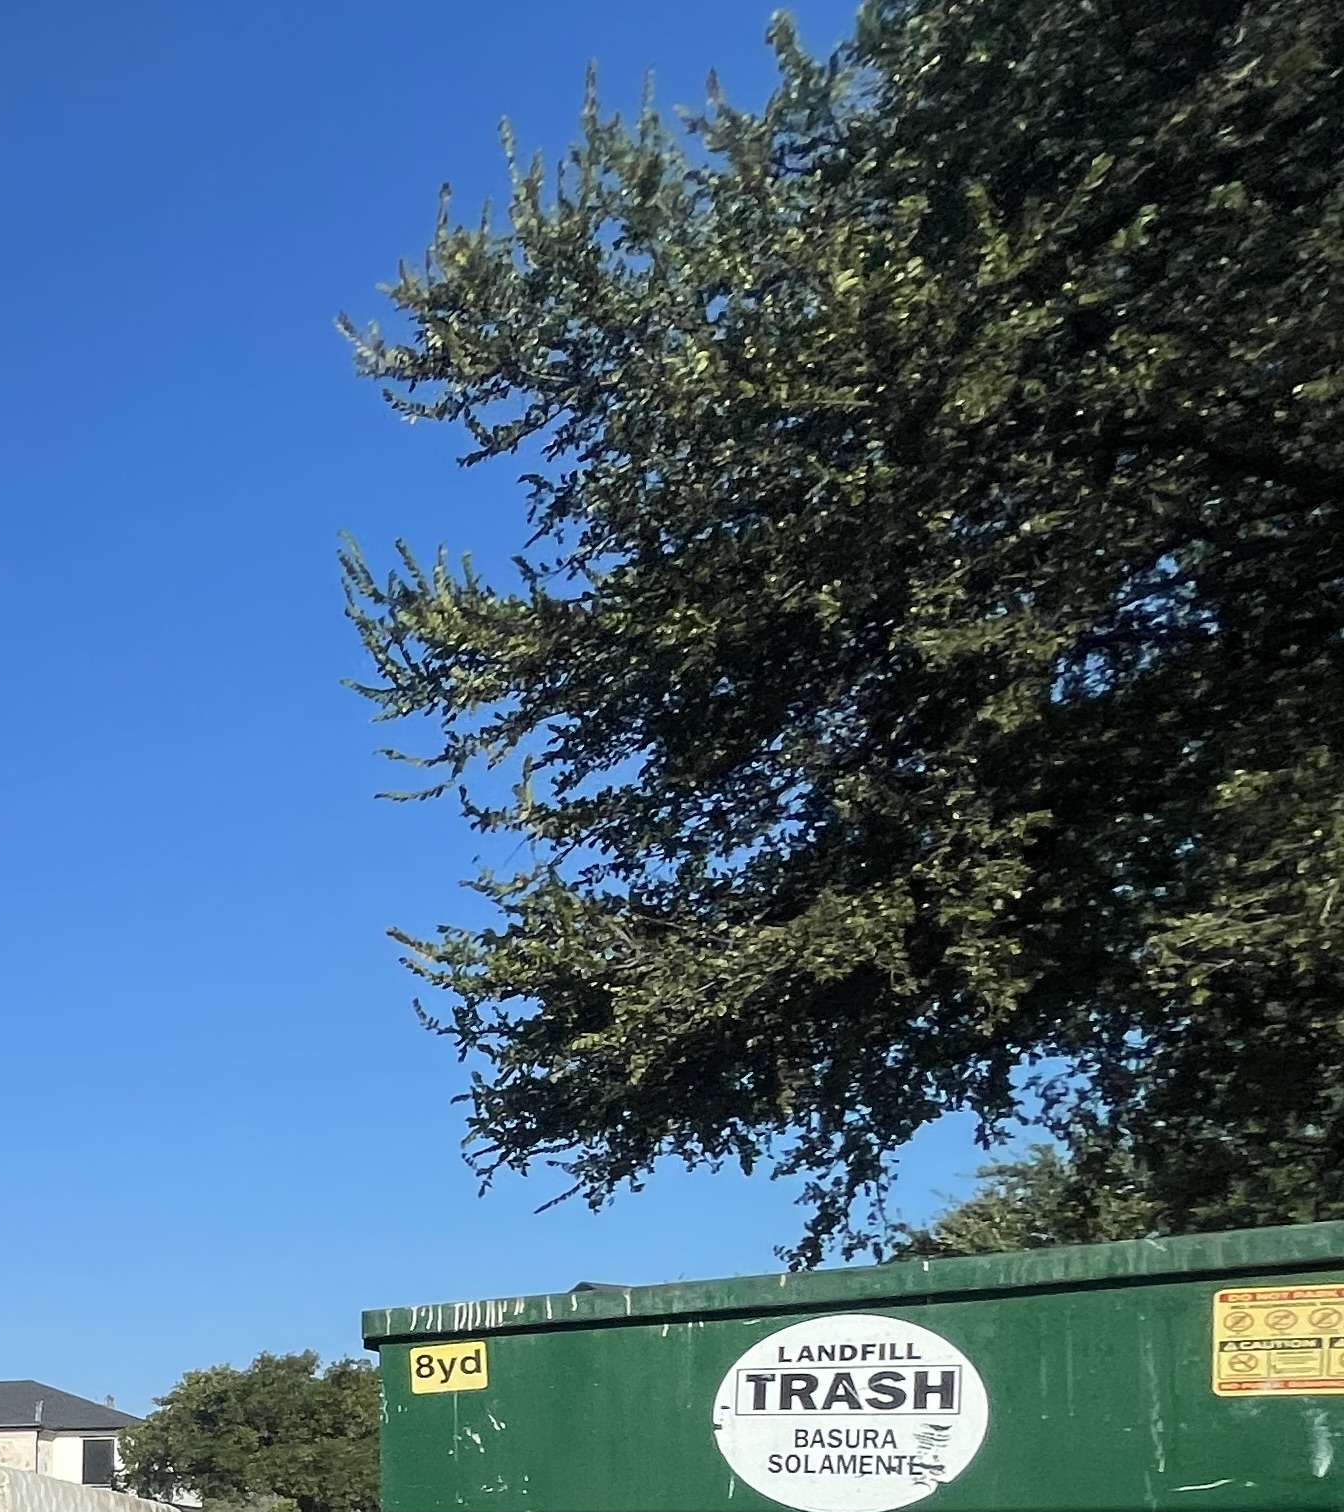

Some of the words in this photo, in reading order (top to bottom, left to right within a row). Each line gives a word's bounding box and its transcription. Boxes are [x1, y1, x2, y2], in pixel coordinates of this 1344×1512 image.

[778, 1343, 922, 1363] LANDFILL
[1240, 1339, 1317, 1350] CAUTION
[415, 1348, 483, 1384] 8yd
[746, 1371, 955, 1411] TRASH
[794, 1428, 898, 1449] BASURA
[767, 1453, 925, 1476] SOLAMENTE
